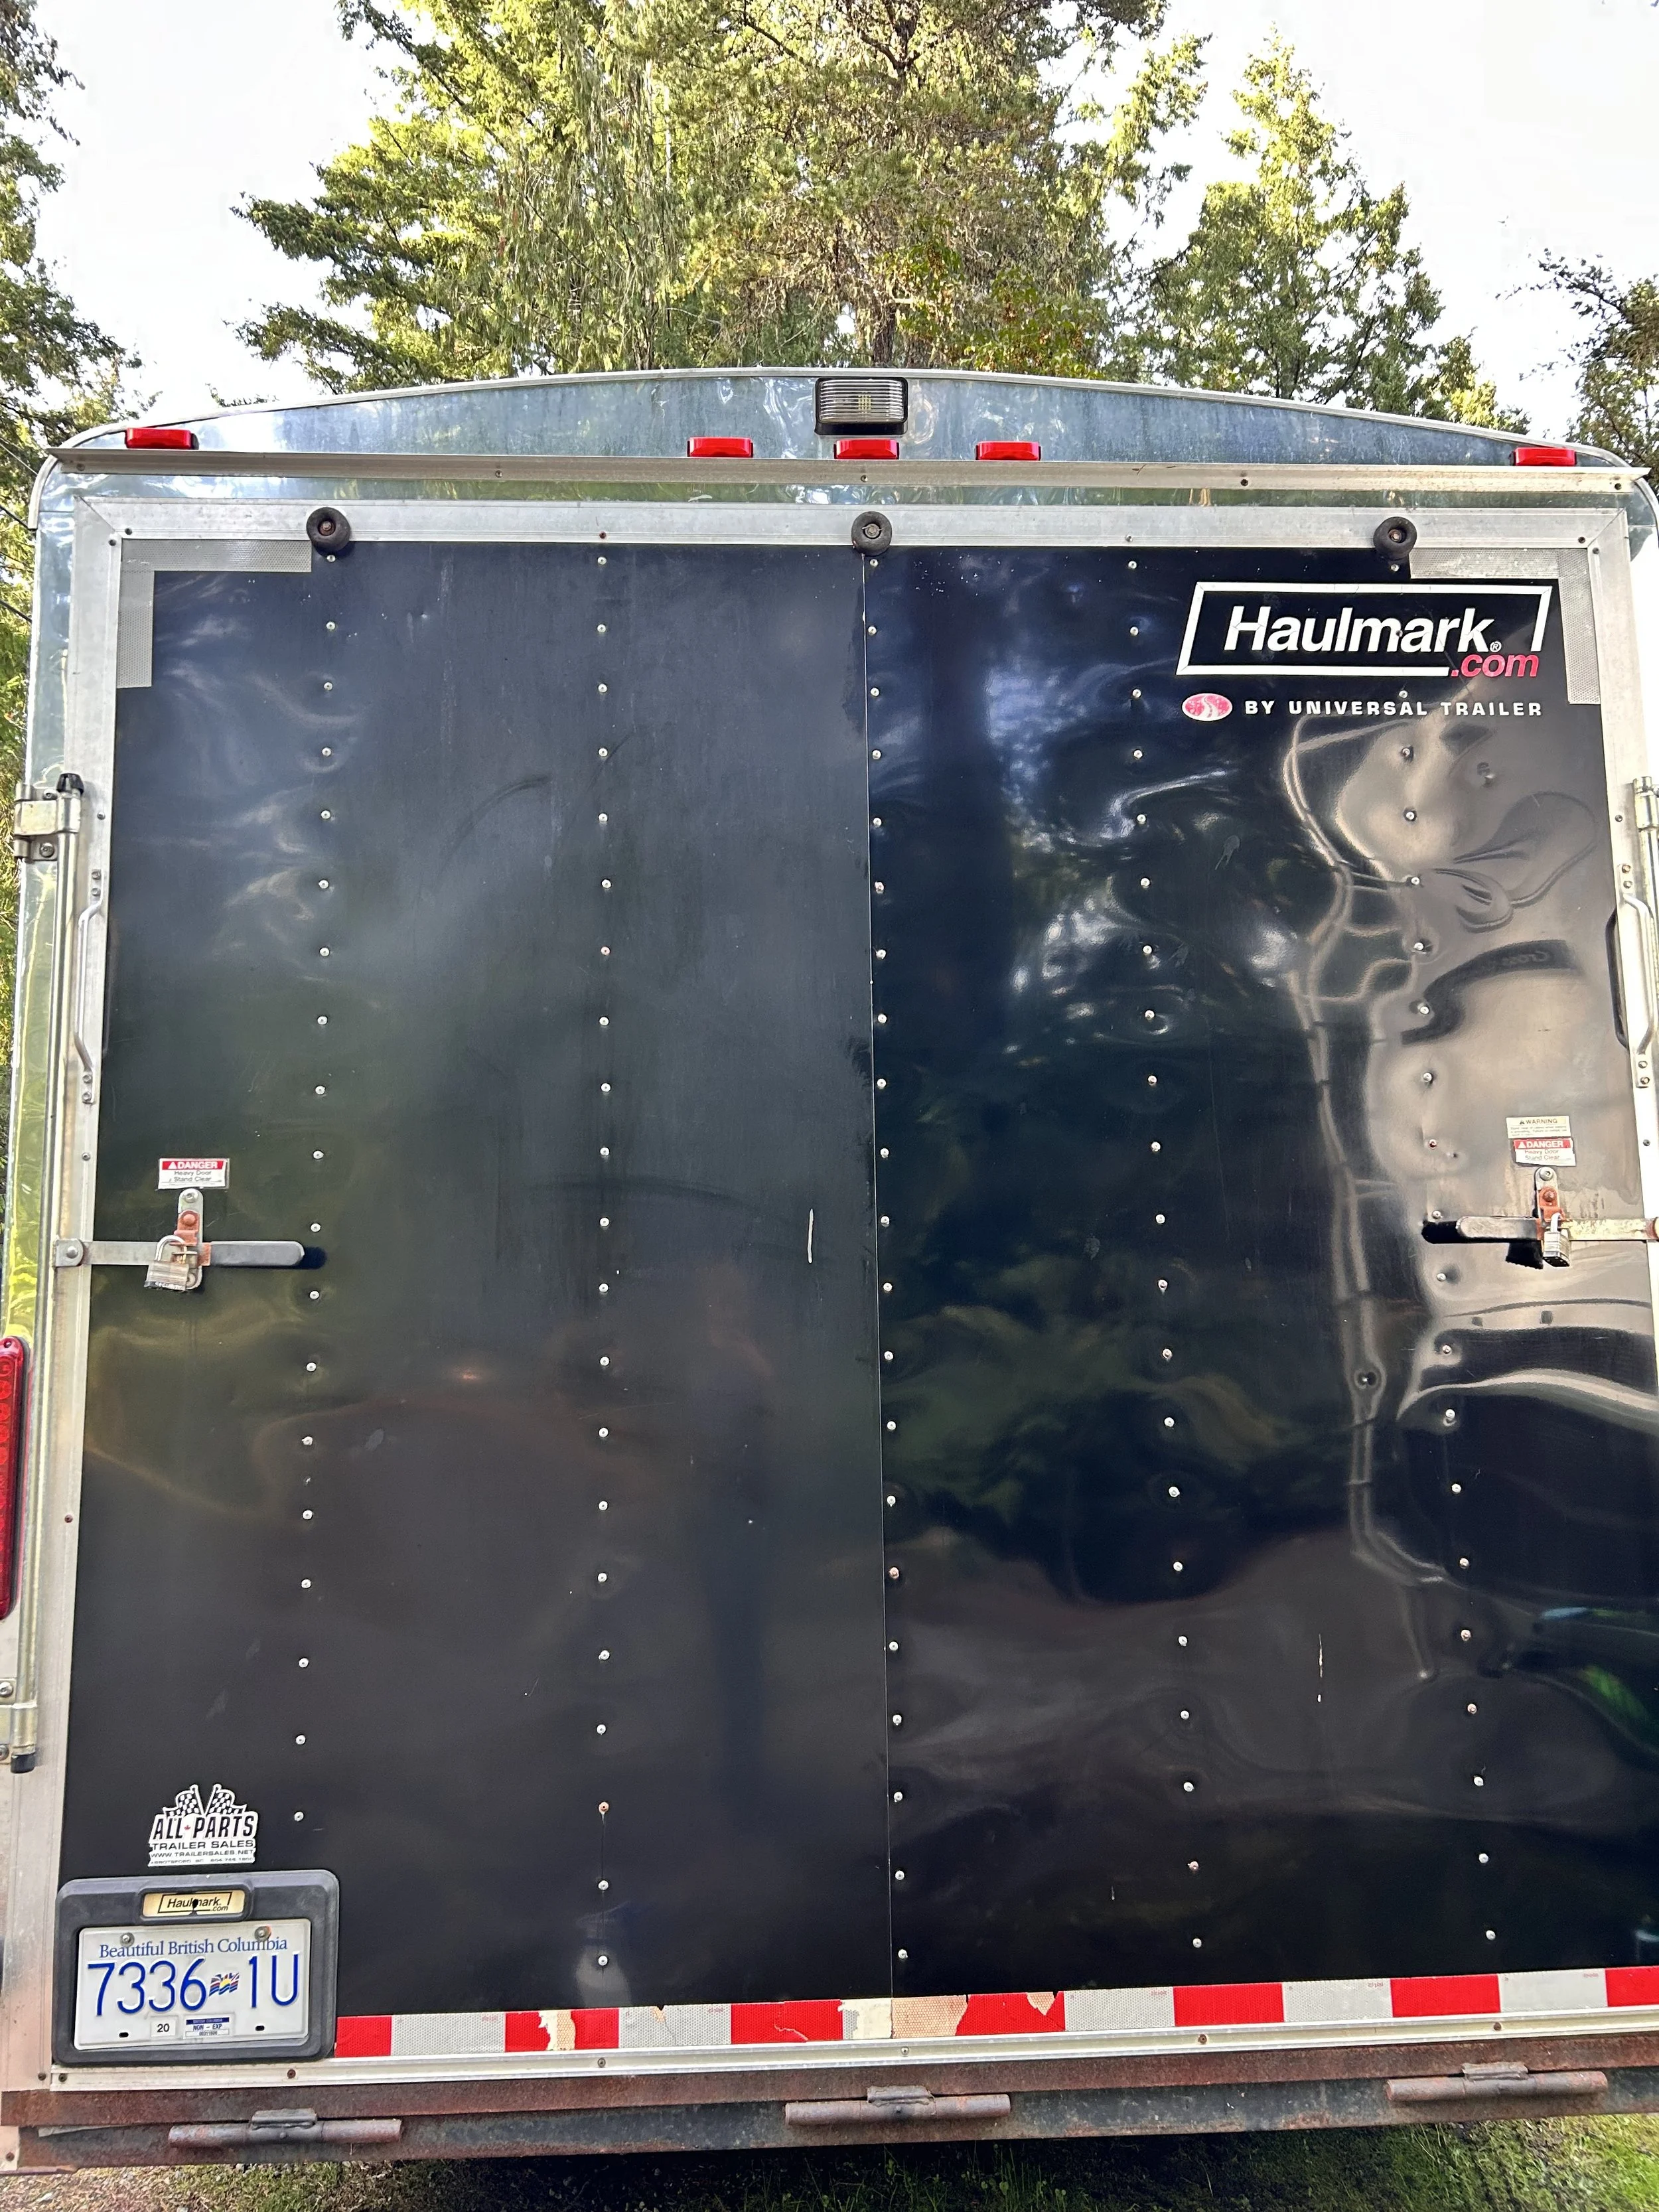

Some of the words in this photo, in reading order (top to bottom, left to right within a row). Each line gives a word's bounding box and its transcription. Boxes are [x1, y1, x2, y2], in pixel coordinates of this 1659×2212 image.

[1451, 653, 1539, 678] .com
[1245, 701, 1273, 715] BY
[1289, 701, 1429, 716] UNIVERSAL
[1440, 701, 1542, 717] TRAILER
[153, 1818, 183, 1840] ALL
[192, 1815, 254, 1838] PARTS
[152, 1842, 206, 1850] TRAILER
[100, 1941, 164, 1958] Beautiful
[168, 1940, 214, 1955] British
[218, 1937, 288, 1953] Columbia
[88, 1958, 206, 2017] 7336
[249, 1953, 299, 2009] 1U
[157, 2023, 170, 2033] 20
